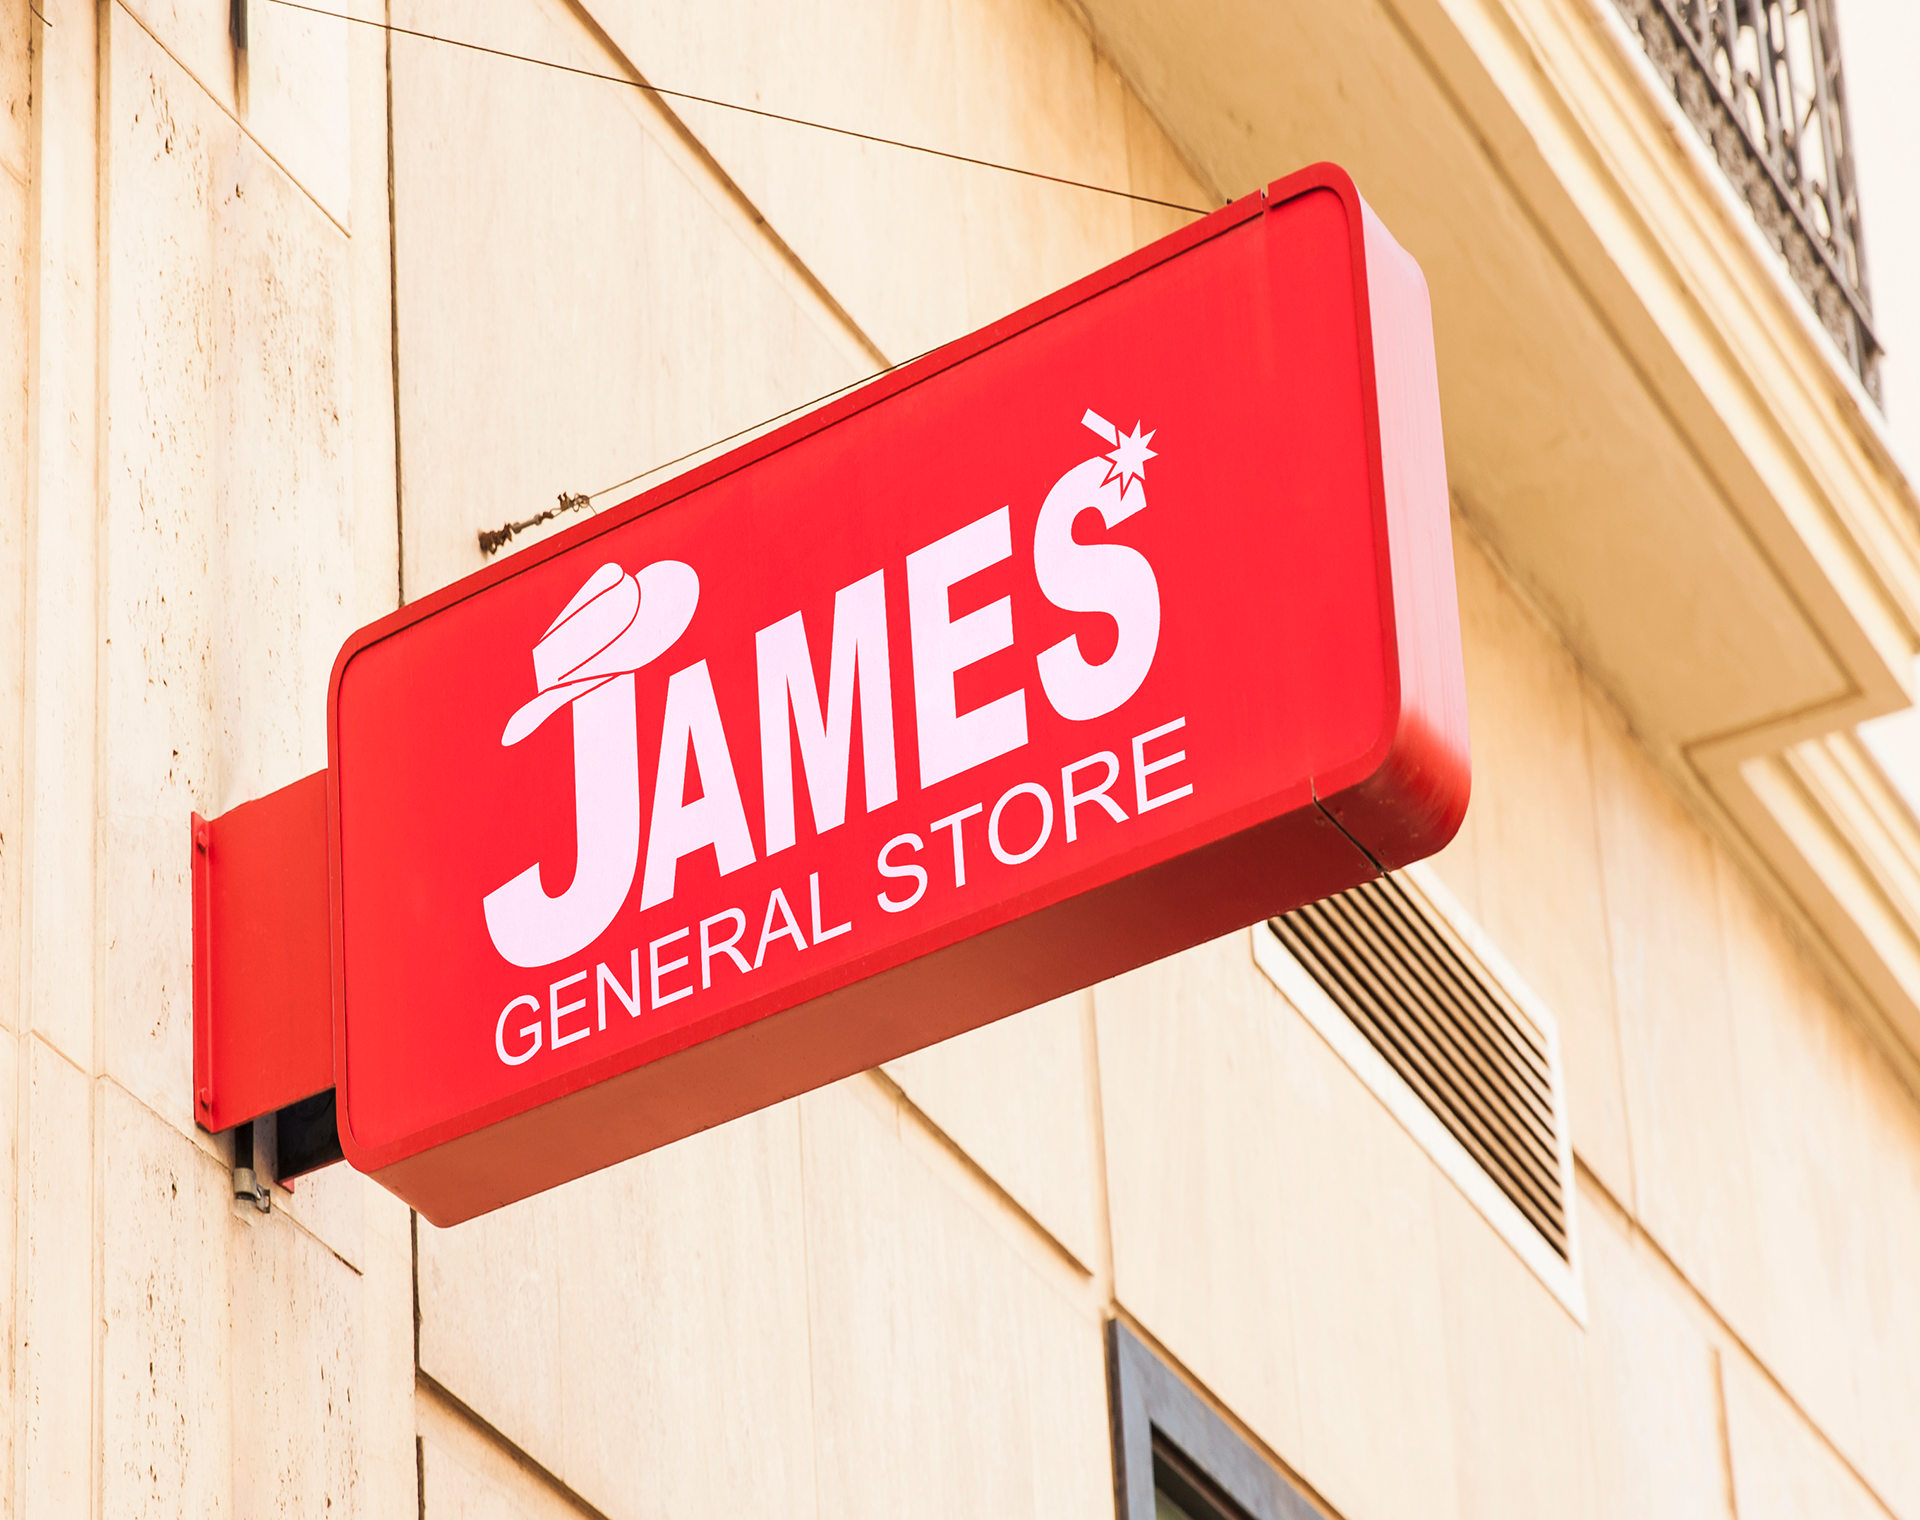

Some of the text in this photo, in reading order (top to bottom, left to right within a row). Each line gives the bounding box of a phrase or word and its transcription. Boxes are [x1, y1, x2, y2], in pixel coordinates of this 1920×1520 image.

[483, 455, 1161, 968] JAMES
[495, 716, 1194, 1066] GENERAL STORE
